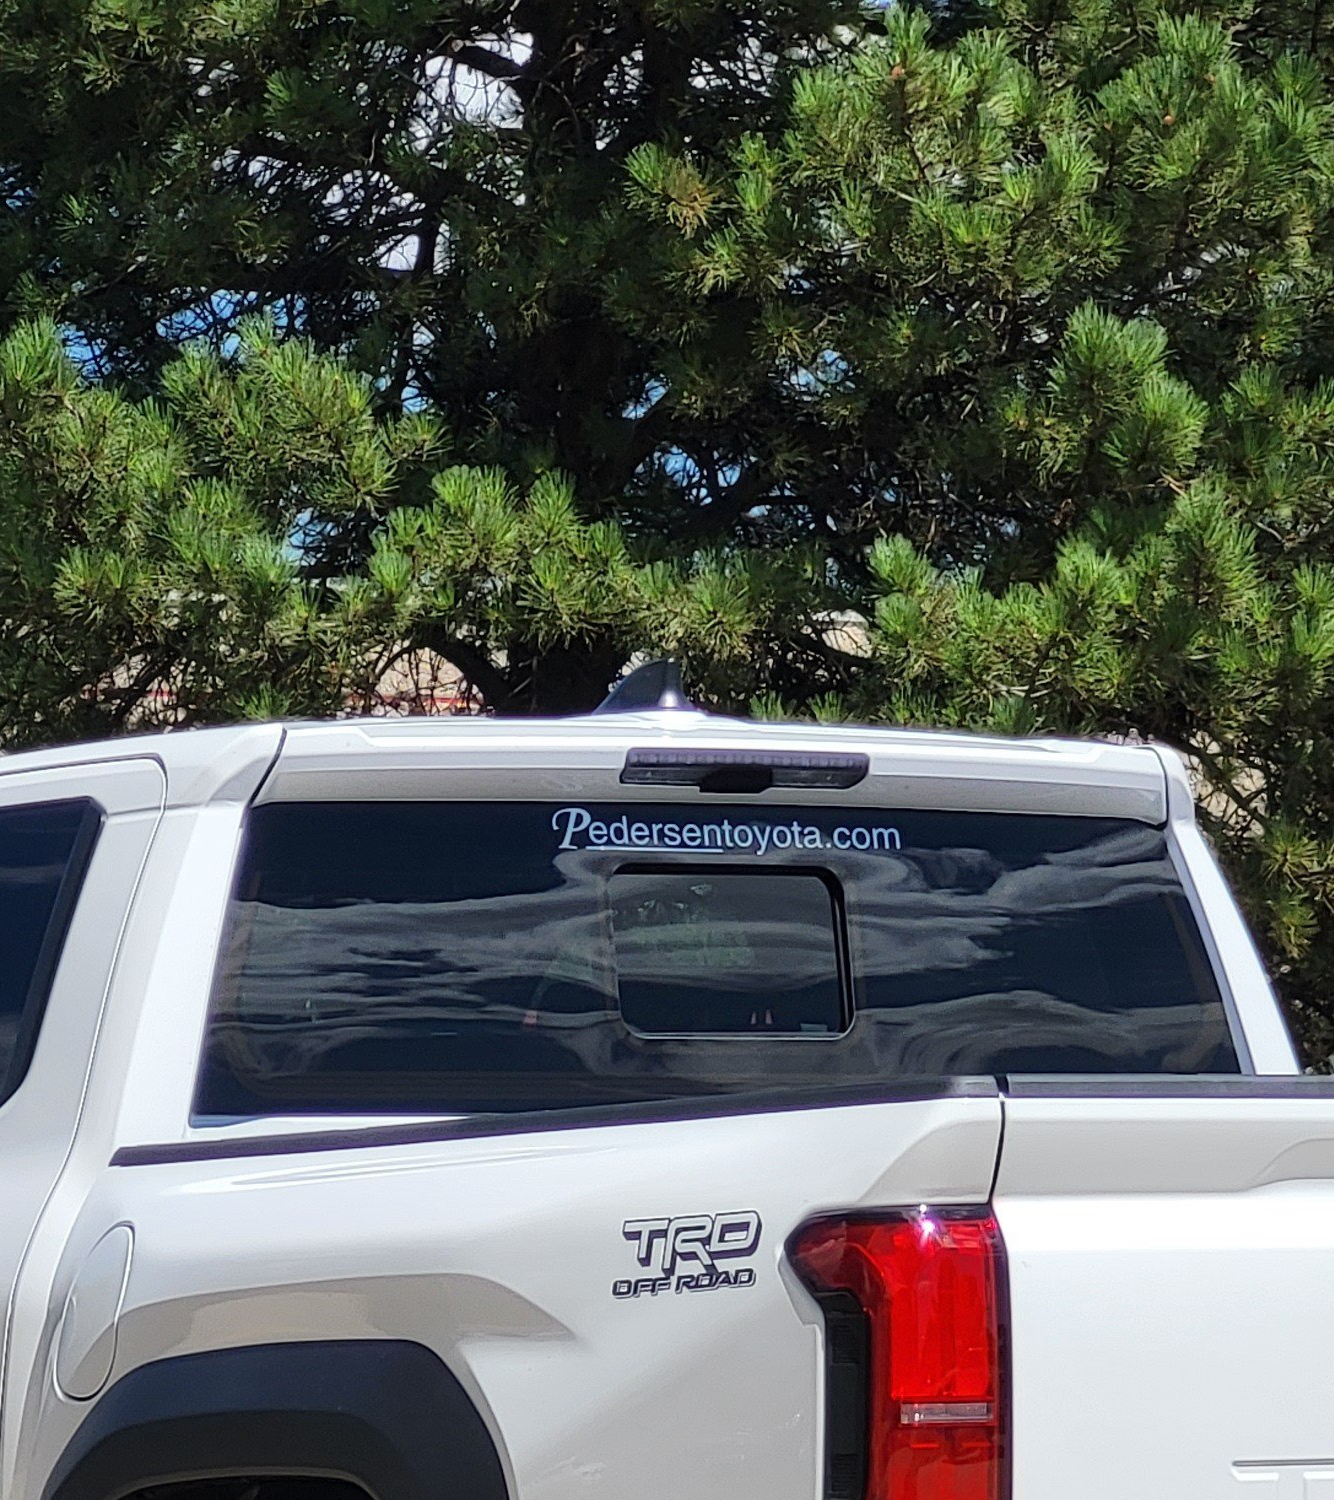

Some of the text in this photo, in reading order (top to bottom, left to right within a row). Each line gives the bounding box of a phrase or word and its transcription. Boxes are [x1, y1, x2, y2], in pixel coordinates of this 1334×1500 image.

[552, 808, 902, 855] Pedersentoyota.com
[622, 1210, 763, 1277] TRD
[612, 1268, 757, 1299] OFF ROAD
